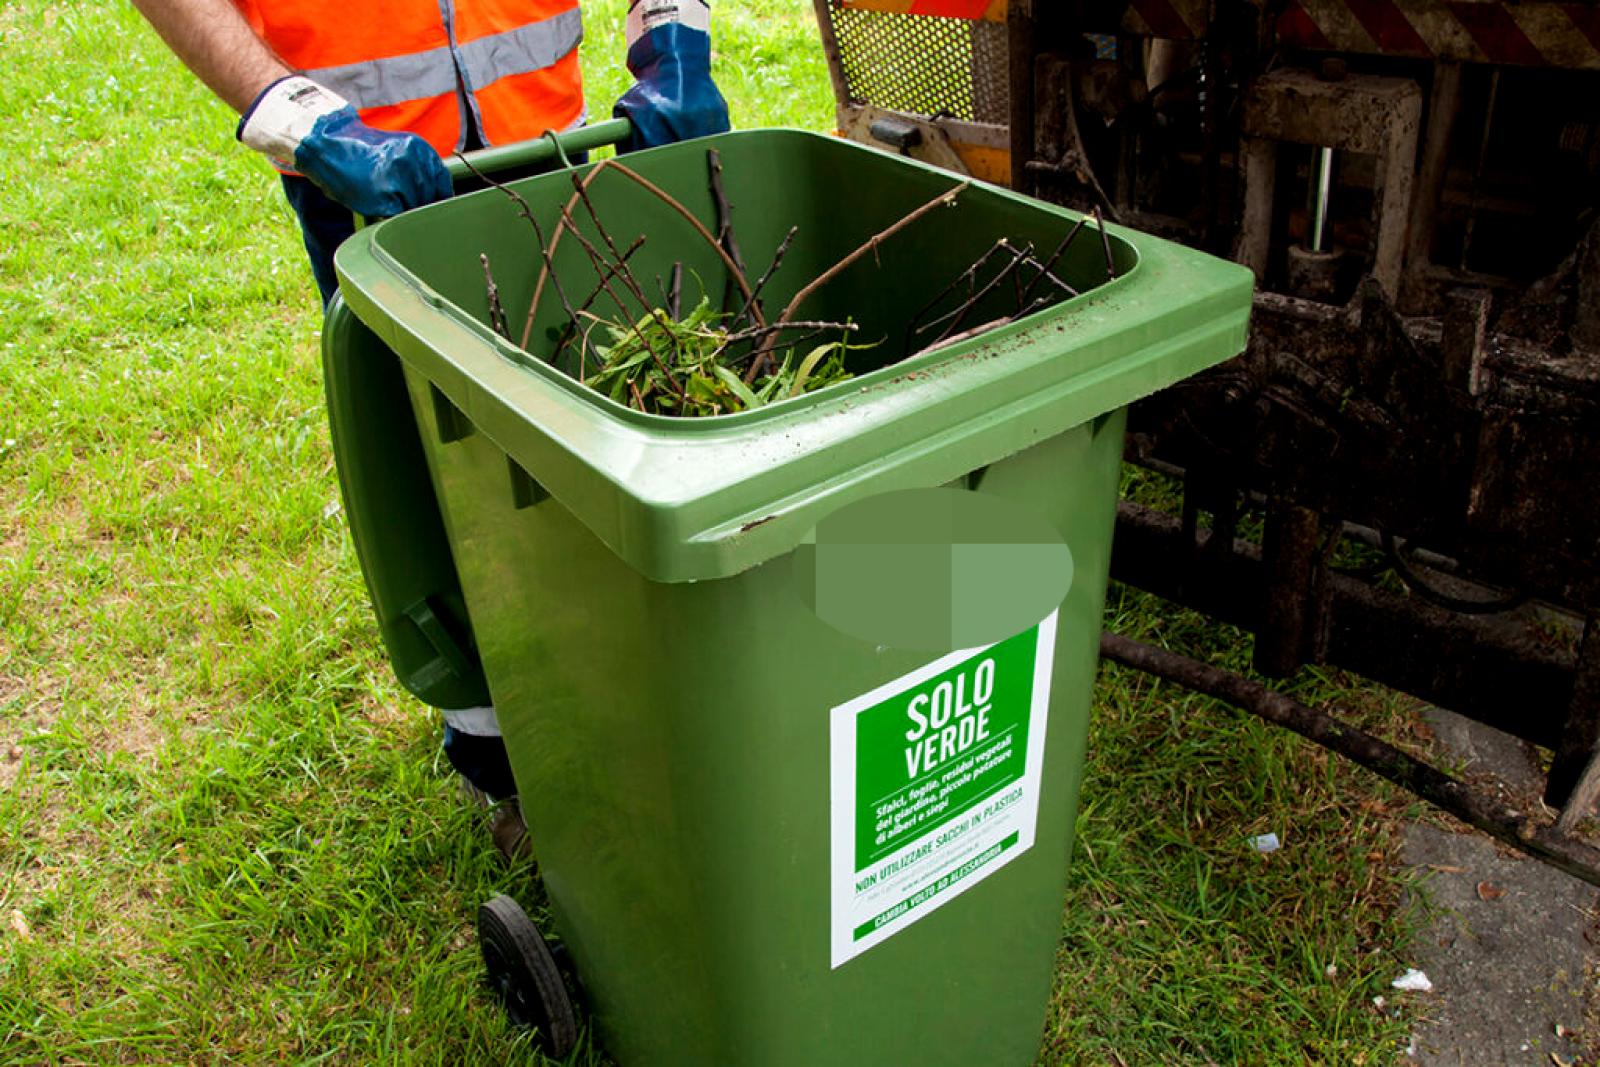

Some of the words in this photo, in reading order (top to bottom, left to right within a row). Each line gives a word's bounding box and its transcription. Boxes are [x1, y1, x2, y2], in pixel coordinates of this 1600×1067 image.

[906, 658, 995, 741] SOLO
[906, 703, 992, 778] VERDE
[876, 795, 907, 819] Sfalci,
[909, 780, 940, 801] foglie,
[942, 755, 974, 783] residui
[976, 735, 1012, 763] vegetali
[876, 815, 893, 832] del
[940, 773, 972, 800] piccole
[973, 749, 1012, 780] potature
[855, 873, 877, 894] NON
[880, 841, 933, 881] UTILIZZARE
[935, 820, 969, 849] SACCHI
[971, 812, 981, 828] IN
[983, 787, 1023, 819] PLASTICA
[876, 831, 887, 845] di
[887, 814, 916, 839] alberi
[918, 811, 925, 822] e
[926, 796, 949, 818] siepi
[874, 899, 908, 928] CAMBIA
[910, 885, 935, 907] VOLTO
[951, 844, 1002, 886] ALESSANDRIA
